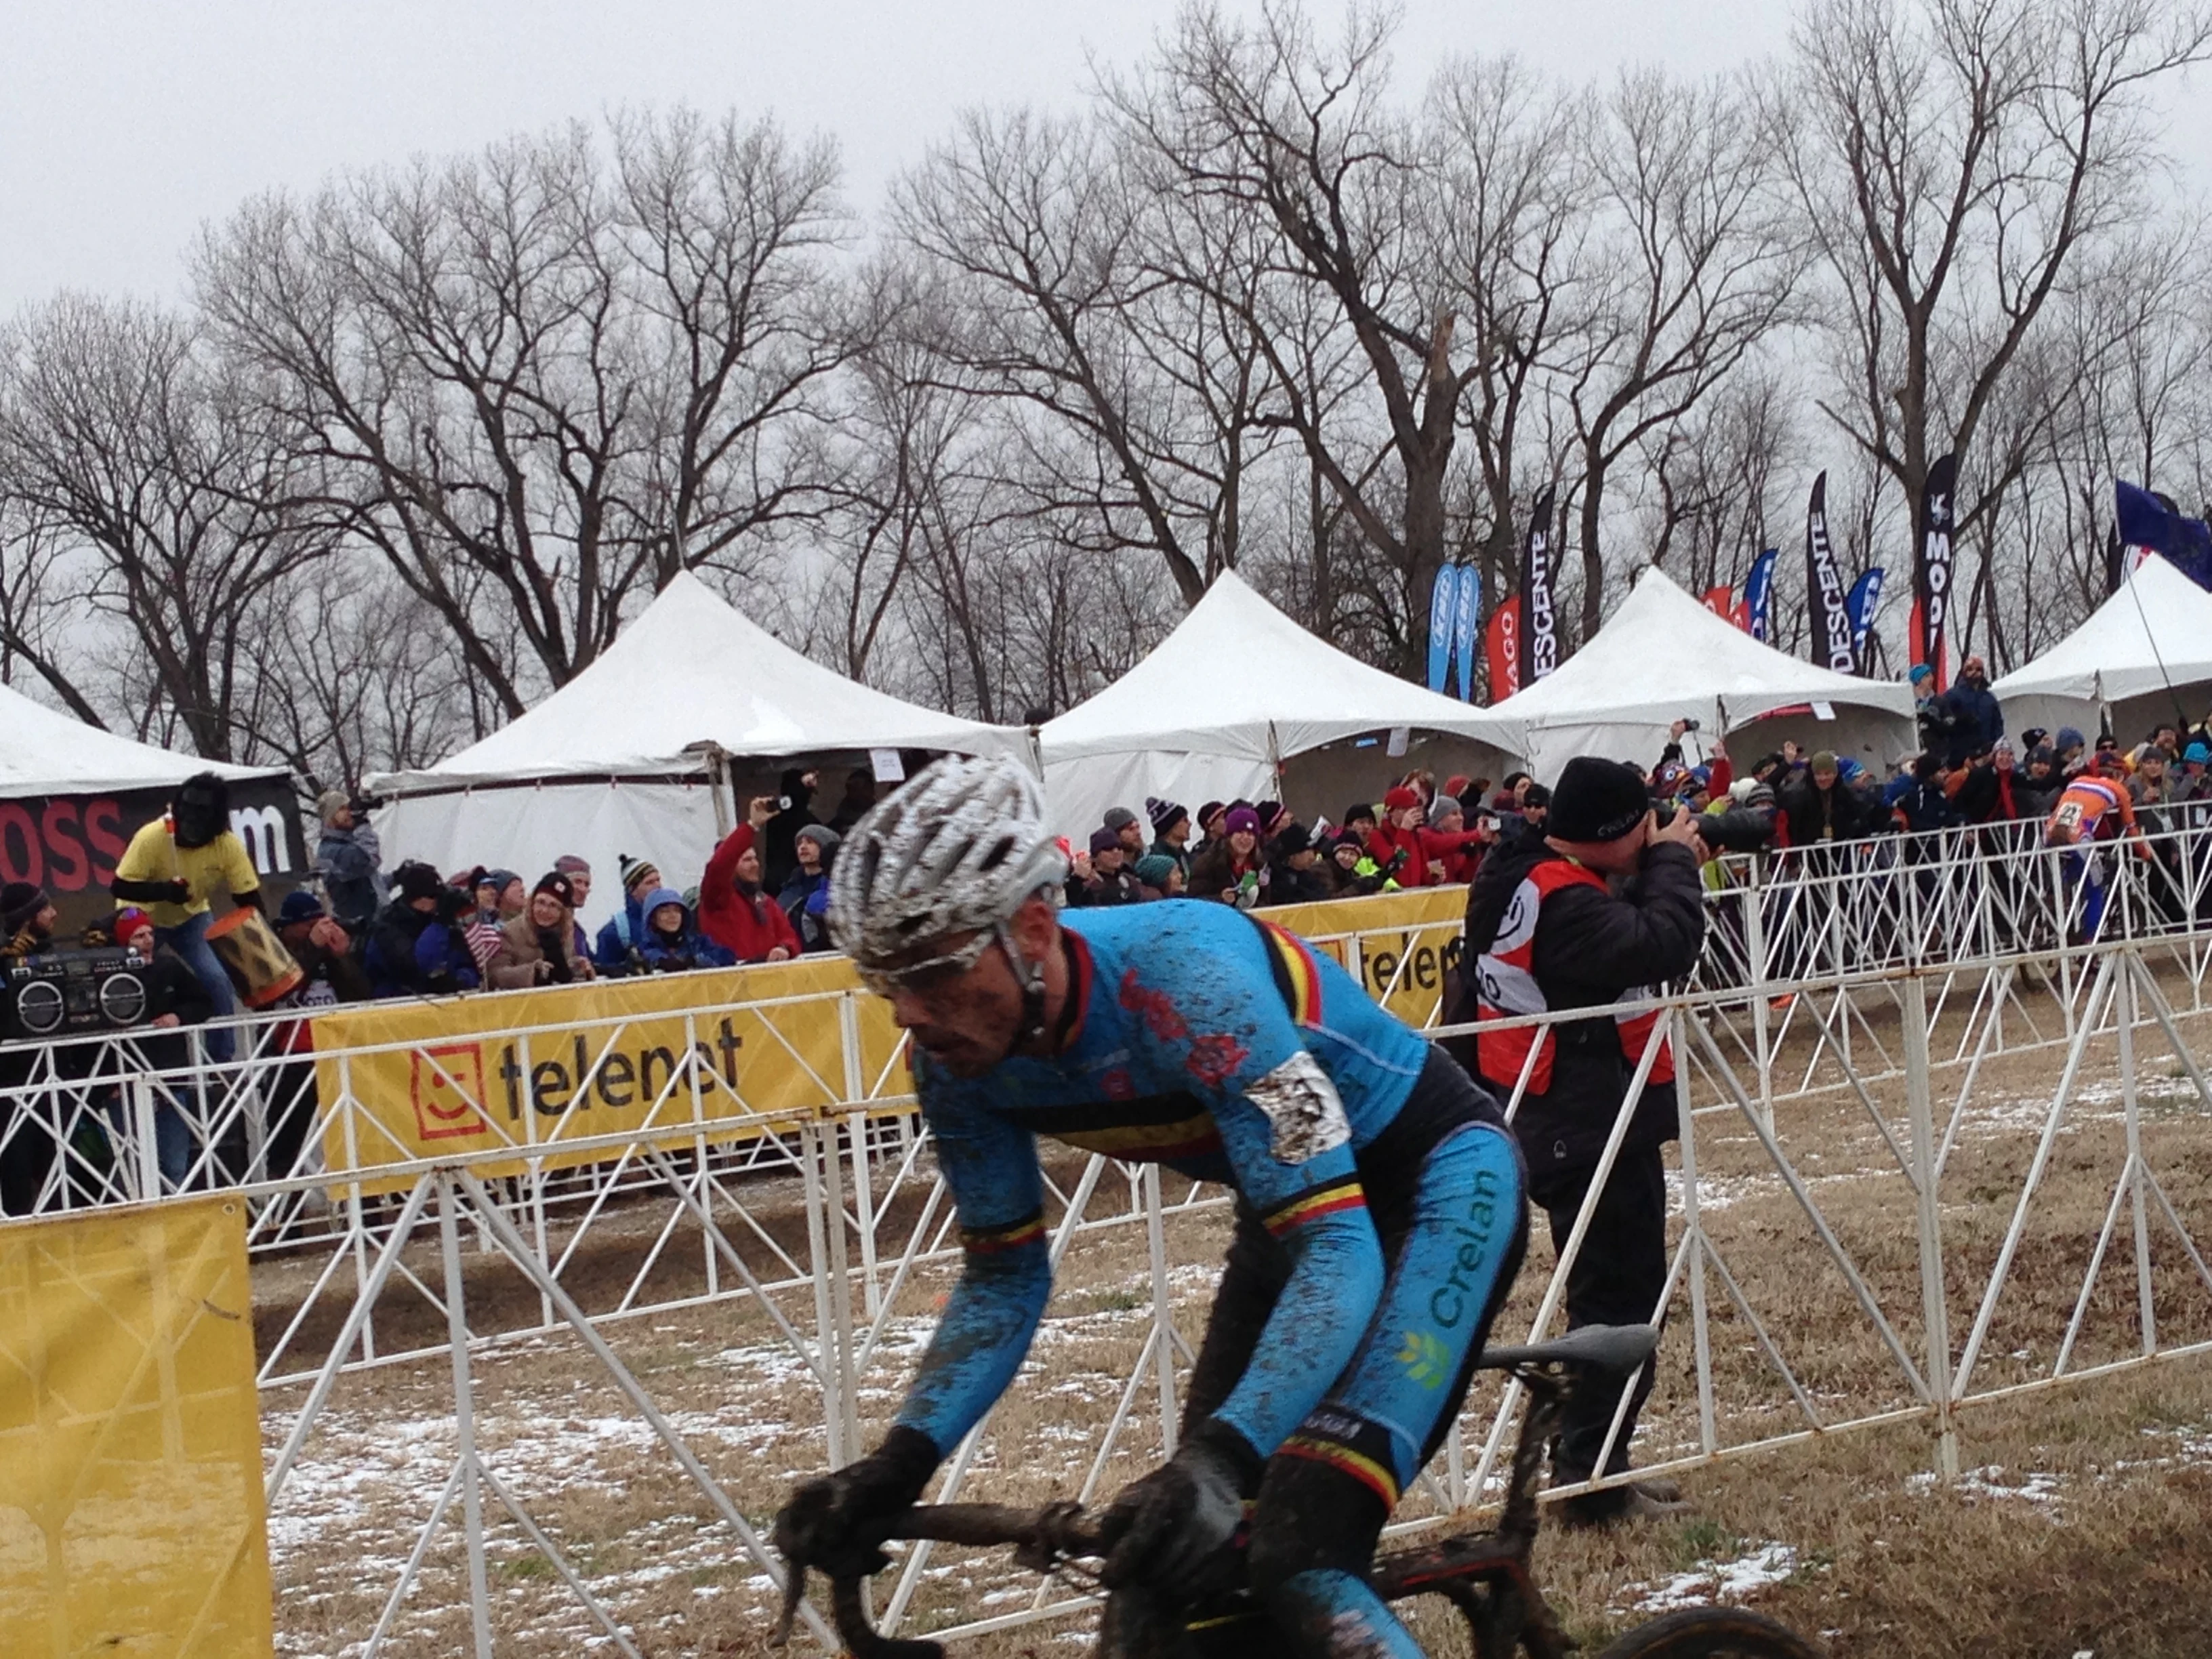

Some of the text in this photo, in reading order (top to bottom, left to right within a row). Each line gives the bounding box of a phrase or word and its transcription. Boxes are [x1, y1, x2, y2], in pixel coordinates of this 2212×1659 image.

[1532, 529, 1557, 678] ESCENTE
[1810, 512, 1855, 674] DESCENTE
[499, 1017, 743, 1120] telenet
[1431, 1170, 1499, 1329] Crelan
